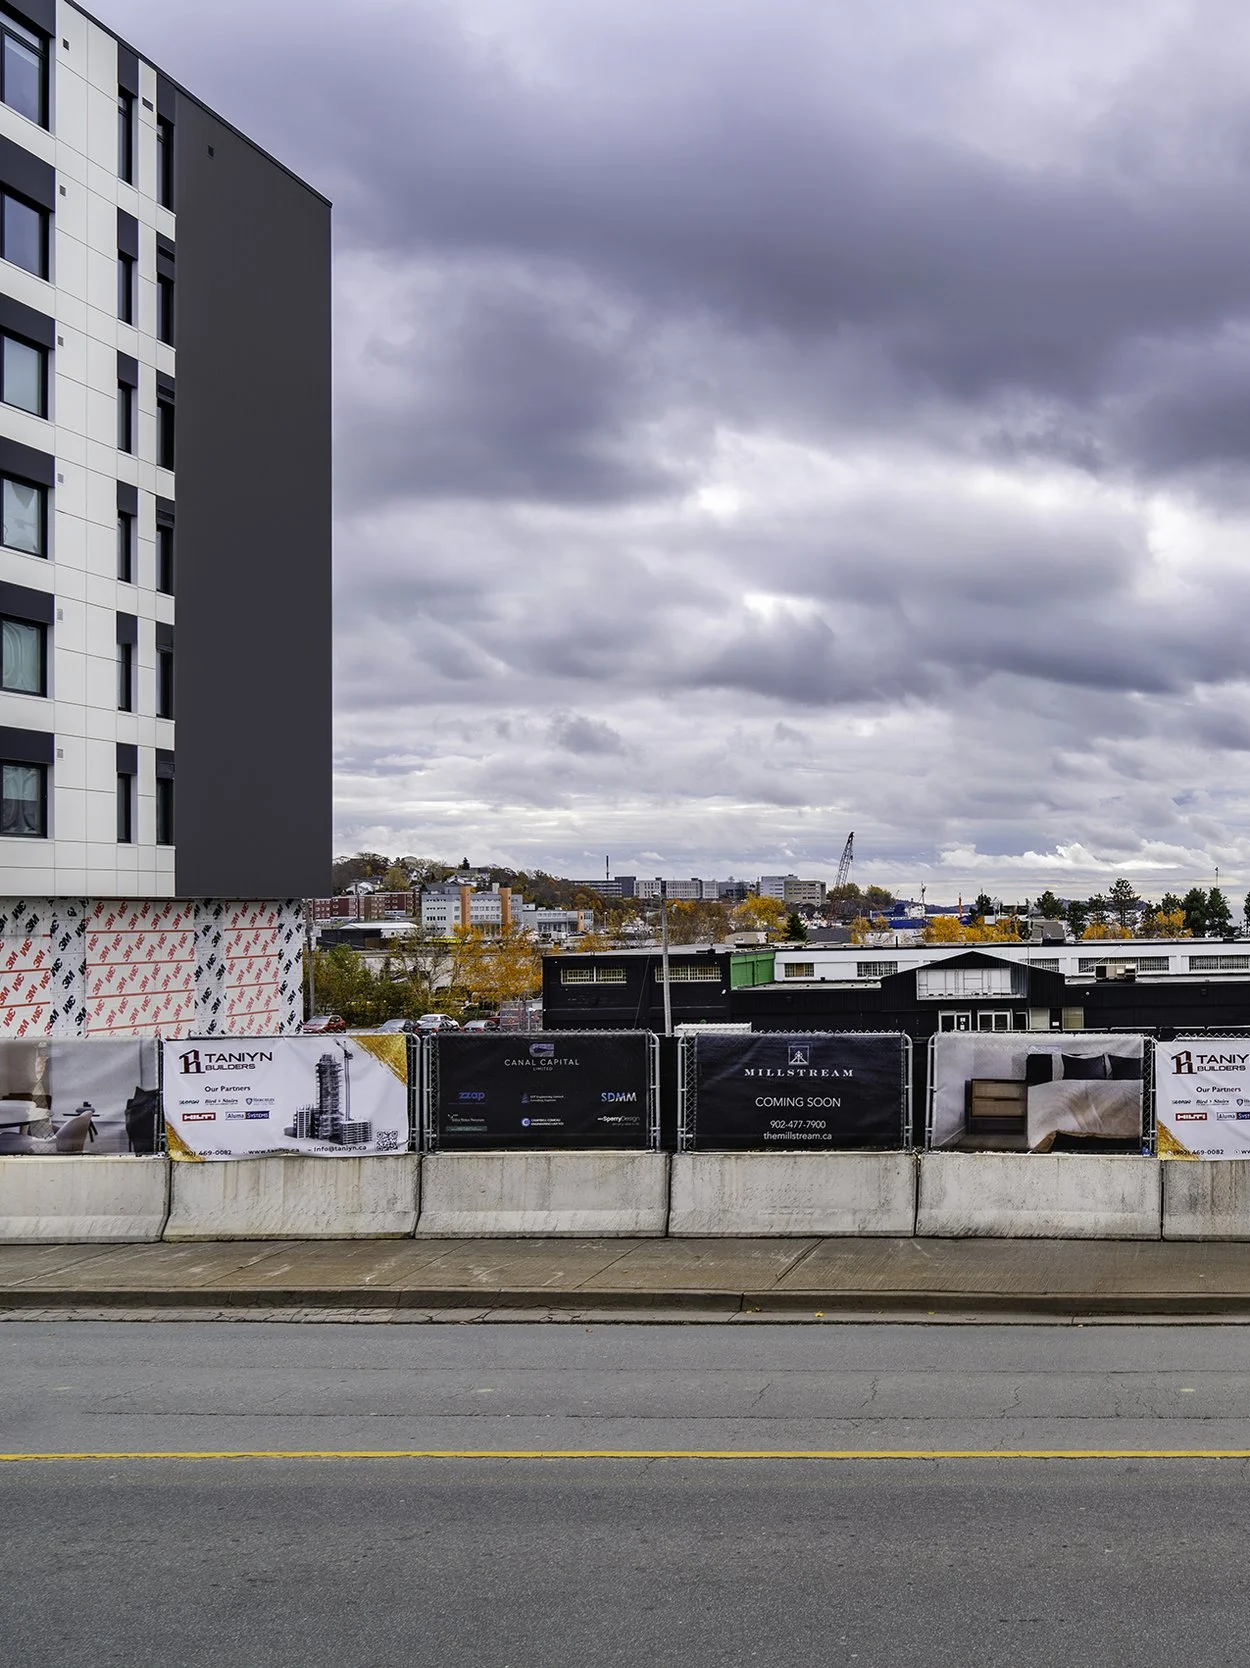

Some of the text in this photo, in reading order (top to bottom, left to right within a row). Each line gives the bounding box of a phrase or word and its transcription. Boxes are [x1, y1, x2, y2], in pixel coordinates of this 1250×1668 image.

[204, 1052, 273, 1063] TANIYN
[540, 1058, 580, 1066] CAPITAL
[205, 1063, 256, 1071] BUILDERS
[744, 1068, 854, 1077] MILLSTREAM
[601, 1092, 637, 1102] SDMM
[755, 1097, 841, 1107] COMING SOON
[770, 1120, 827, 1129] 902-477-7900
[763, 1131, 832, 1140] themillstream.ca
